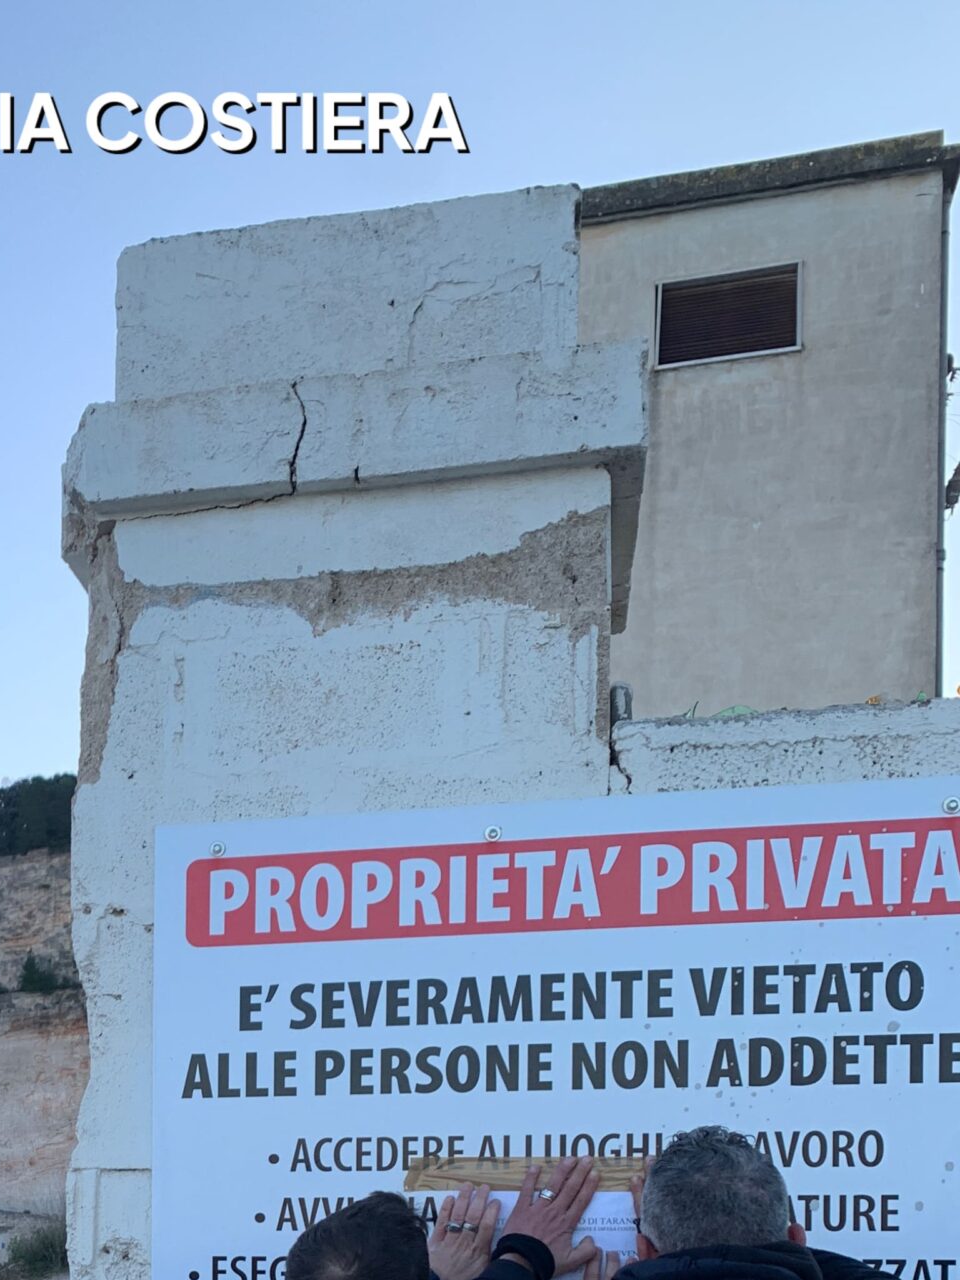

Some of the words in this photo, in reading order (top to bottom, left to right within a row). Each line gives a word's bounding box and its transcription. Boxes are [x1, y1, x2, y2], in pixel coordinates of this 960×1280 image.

[640, 829, 960, 915] PRIVATA
[289, 968, 674, 1030] SEVERAMENTE
[689, 960, 925, 1018] VIETATO
[182, 1052, 297, 1099] ALLE
[315, 1044, 553, 1097] PERSONE
[571, 1039, 689, 1090] NON
[290, 1136, 464, 1171] ACCEDERE
